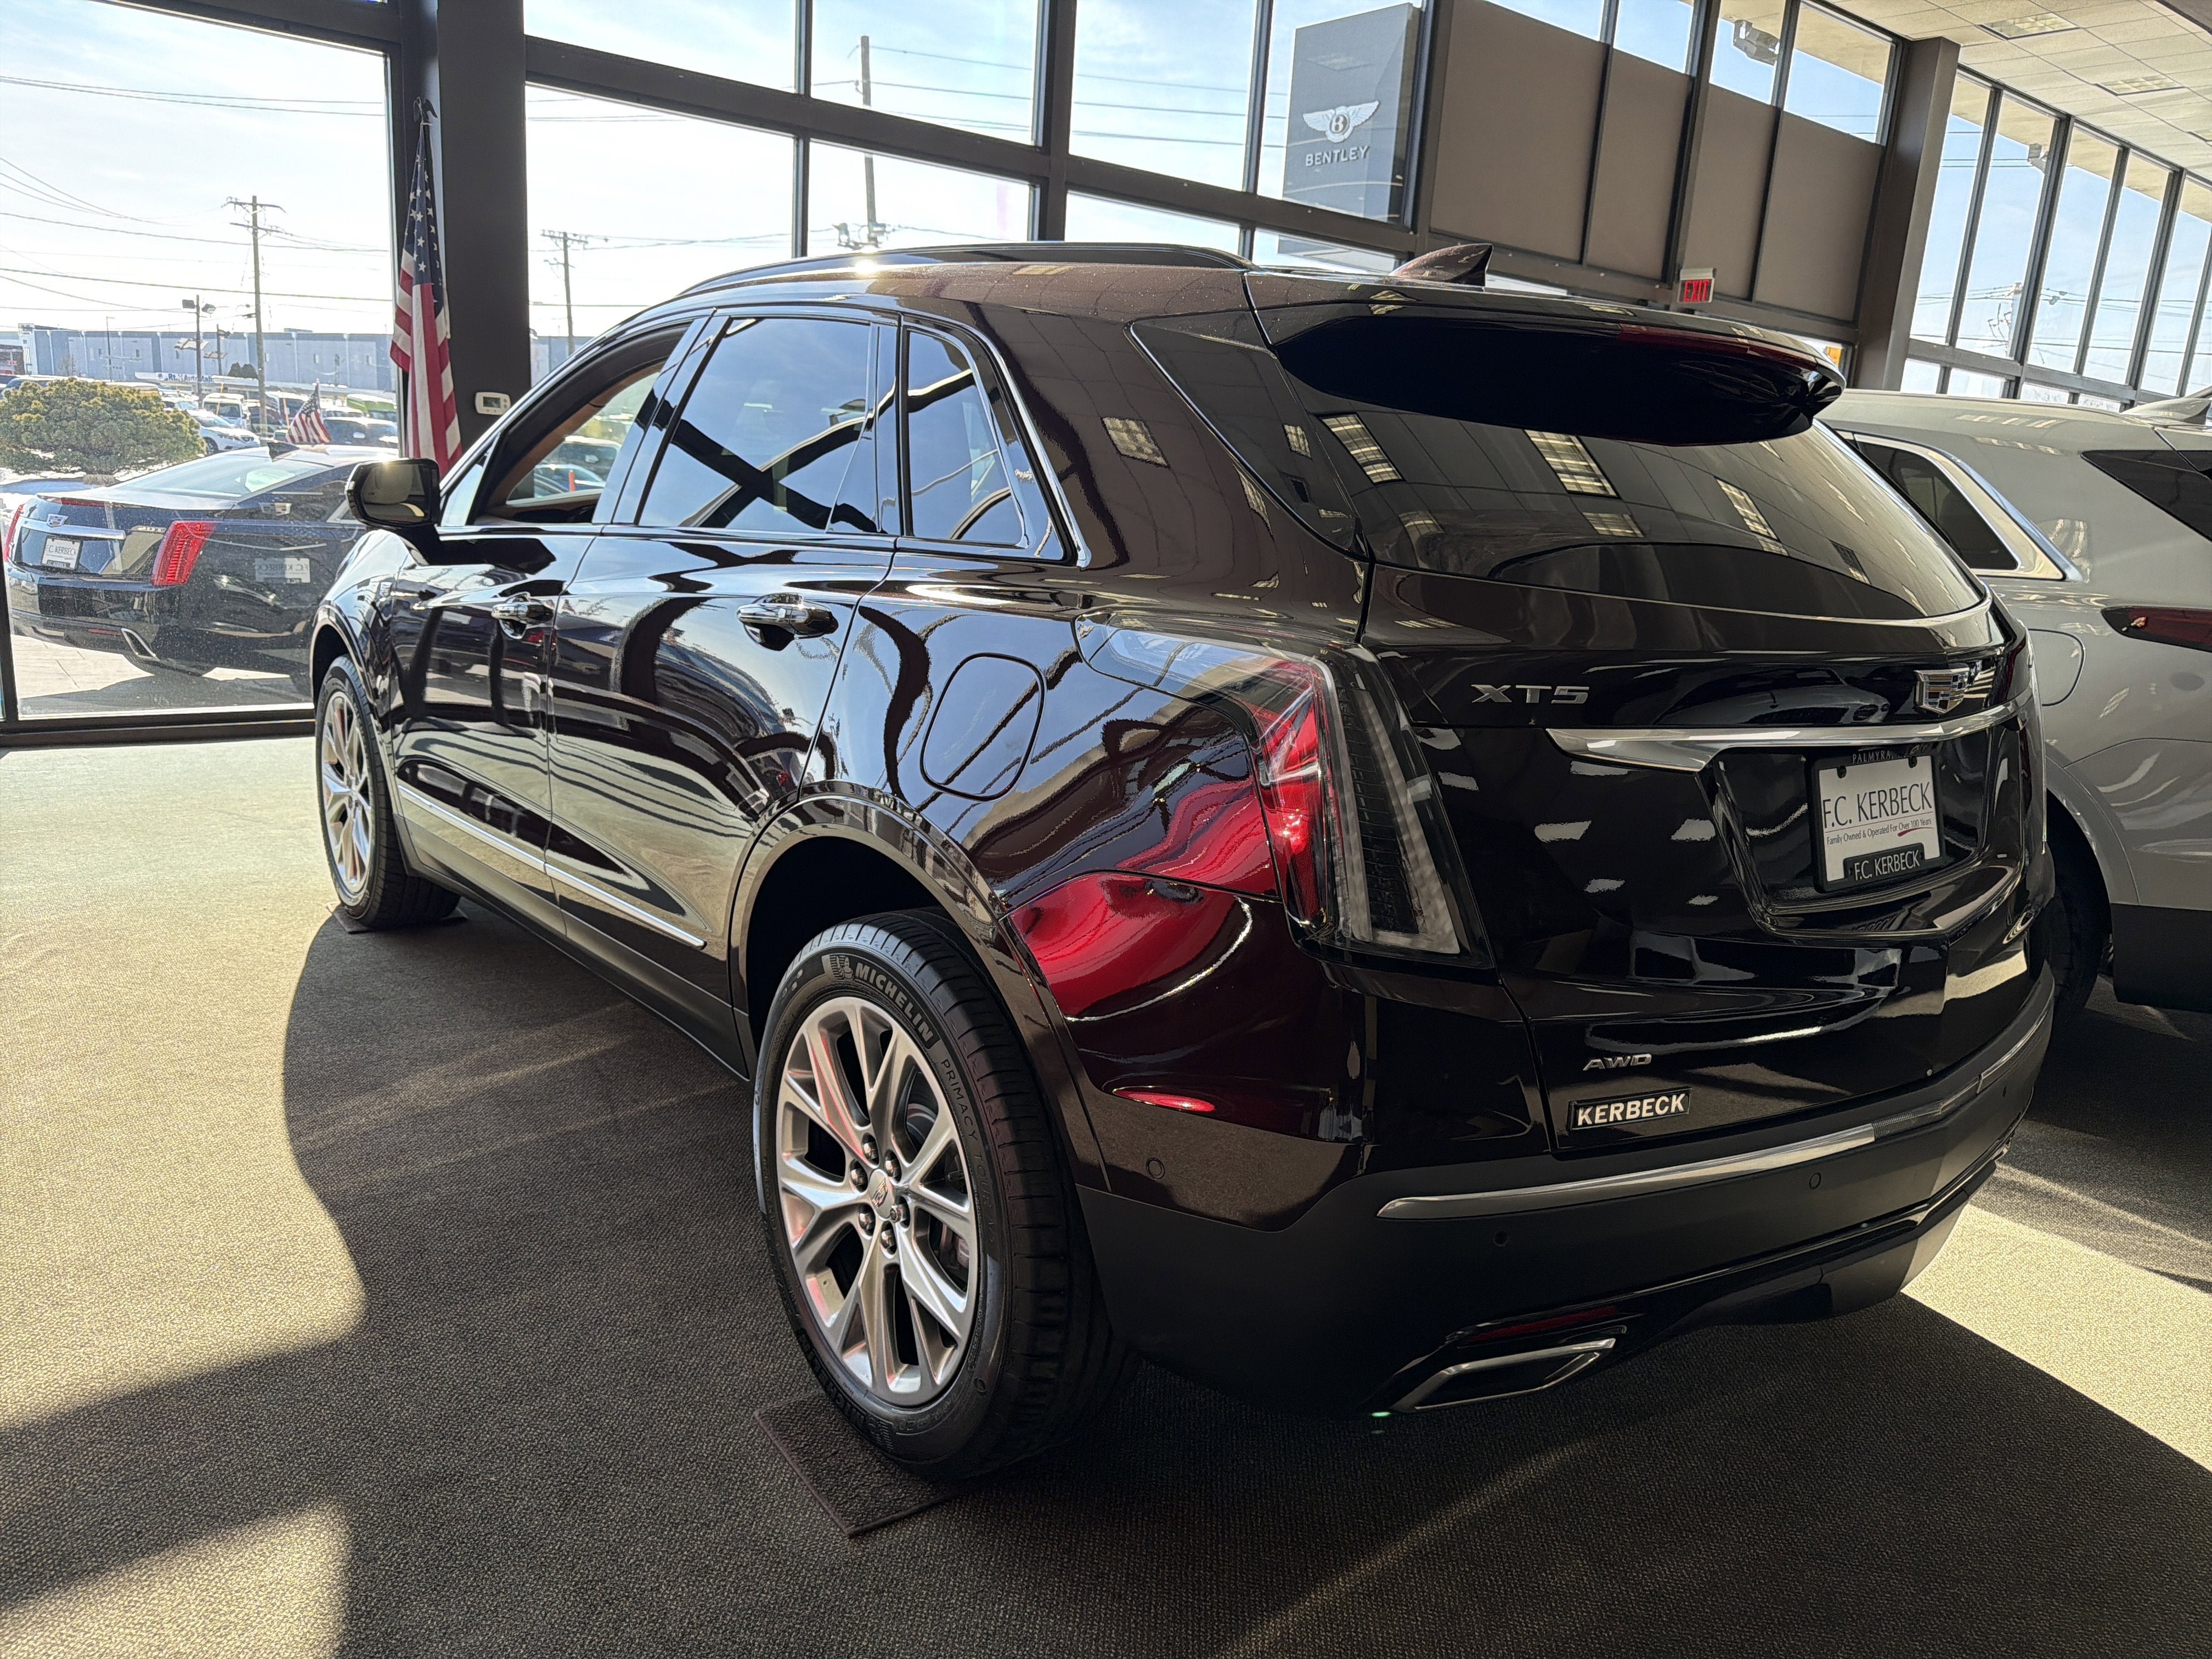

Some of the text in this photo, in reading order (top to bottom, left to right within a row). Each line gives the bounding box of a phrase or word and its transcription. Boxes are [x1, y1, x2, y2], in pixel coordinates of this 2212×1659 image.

[1305, 145, 1369, 167] BENTLEY
[1683, 280, 1709, 302] EXIT
[1471, 685, 1589, 704] XT5
[1822, 782, 1932, 828] F.C. KERBECK
[1827, 834, 1843, 845] Family
[1843, 832, 1861, 842] Owned
[1867, 825, 1889, 838] Operated
[1898, 822, 1910, 831] Over
[1910, 819, 1920, 827] 100
[1920, 818, 1932, 826] Years
[1854, 850, 1920, 881] F.C. KERBECK
[854, 962, 934, 1042] MICHELIN
[1583, 1053, 1652, 1071] AWD
[941, 1059, 978, 1142] PRIMACY
[1577, 1093, 1686, 1126] KERBECK
